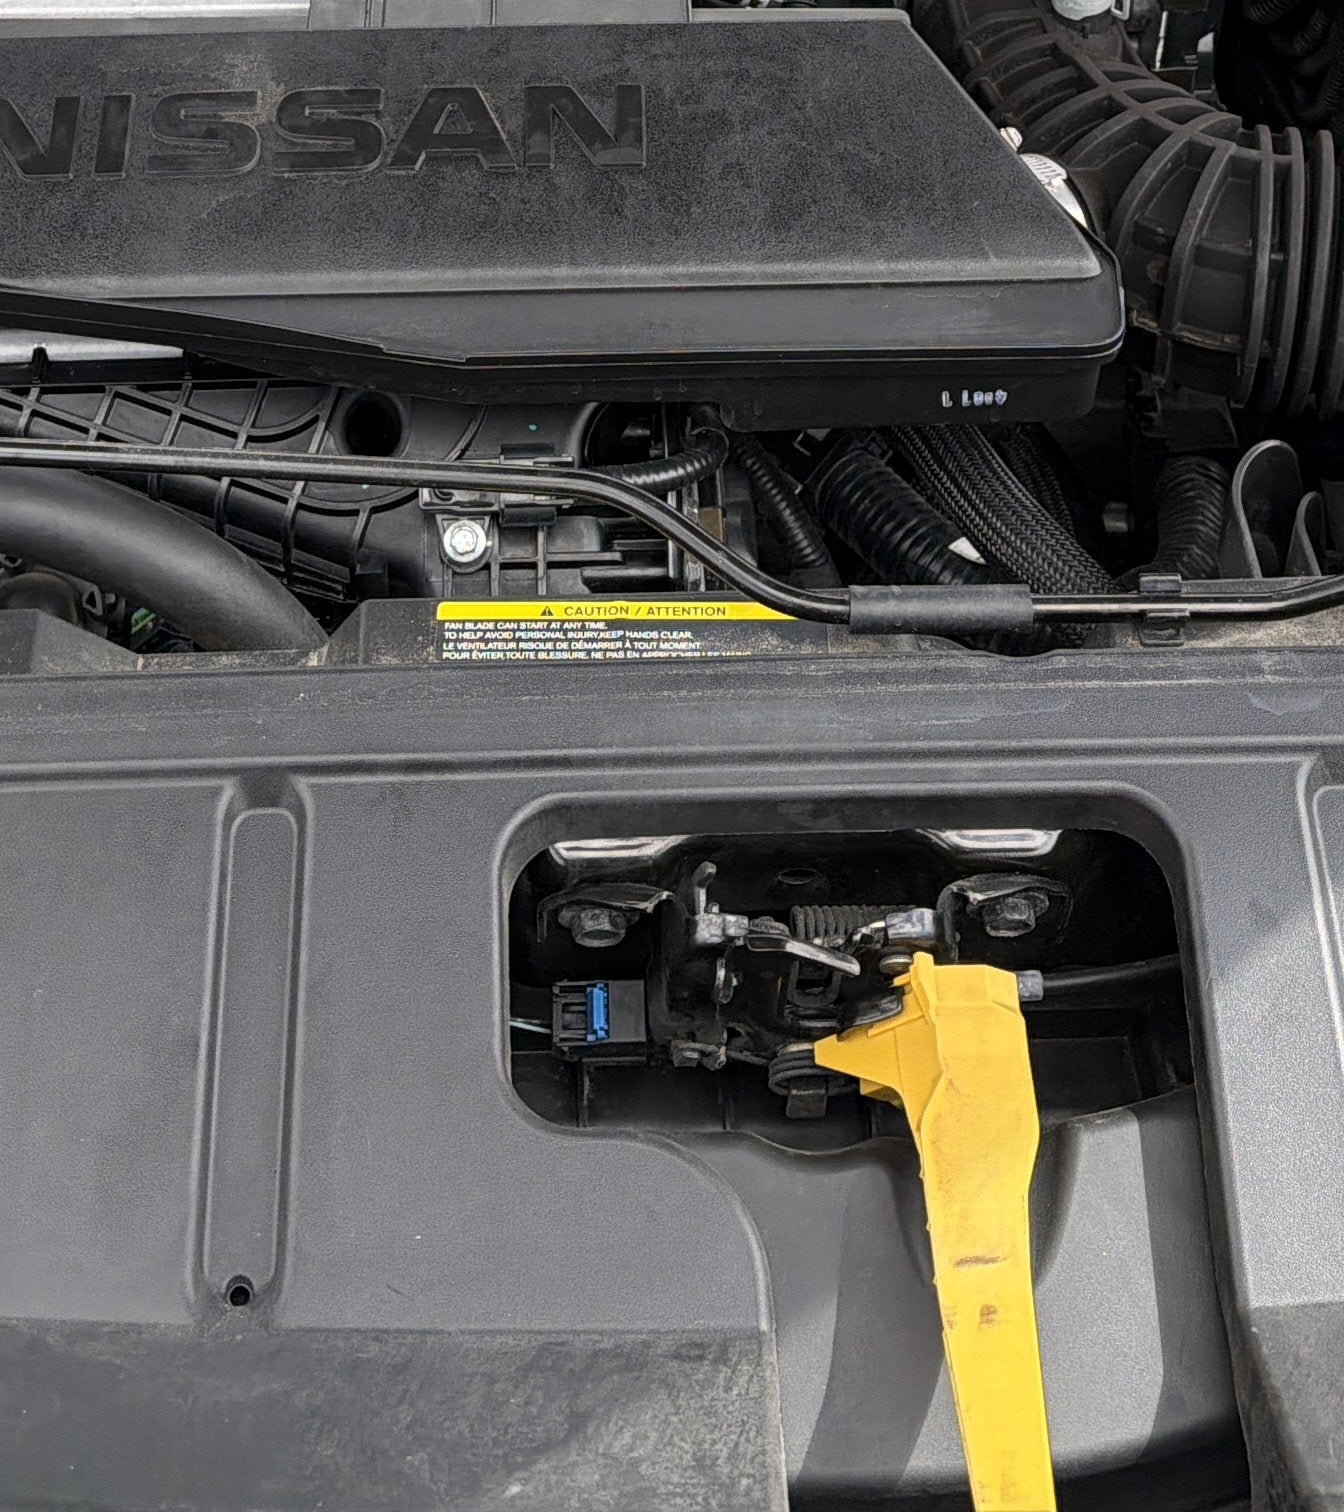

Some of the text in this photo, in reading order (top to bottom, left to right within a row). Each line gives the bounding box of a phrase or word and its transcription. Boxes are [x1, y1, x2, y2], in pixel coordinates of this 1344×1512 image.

[564, 605, 629, 617] CAUTION
[646, 606, 726, 616] ATTENTION
[444, 622, 462, 630] FAN
[465, 622, 495, 630] BLADE
[497, 622, 517, 630] CAN
[519, 622, 547, 630] START
[550, 622, 560, 630] AT
[563, 622, 583, 630] ANY
[444, 631, 456, 639] TO
[459, 631, 483, 639] HELP
[485, 631, 513, 639] AVOID
[515, 631, 565, 639] PERSONAL
[625, 631, 658, 639] HANDS
[443, 642, 455, 650] LE
[456, 642, 517, 650] VENTILATEUR
[519, 642, 554, 650] RISQUE
[556, 642, 569, 650] DE
[570, 640, 622, 650] DÉMARRER
[634, 642, 658, 650] TOUT
[443, 651, 470, 660] POUR
[506, 651, 536, 660] TOUTE
[591, 651, 605, 660] NE
[606, 651, 625, 660] PAS
[626, 651, 640, 660] EN
